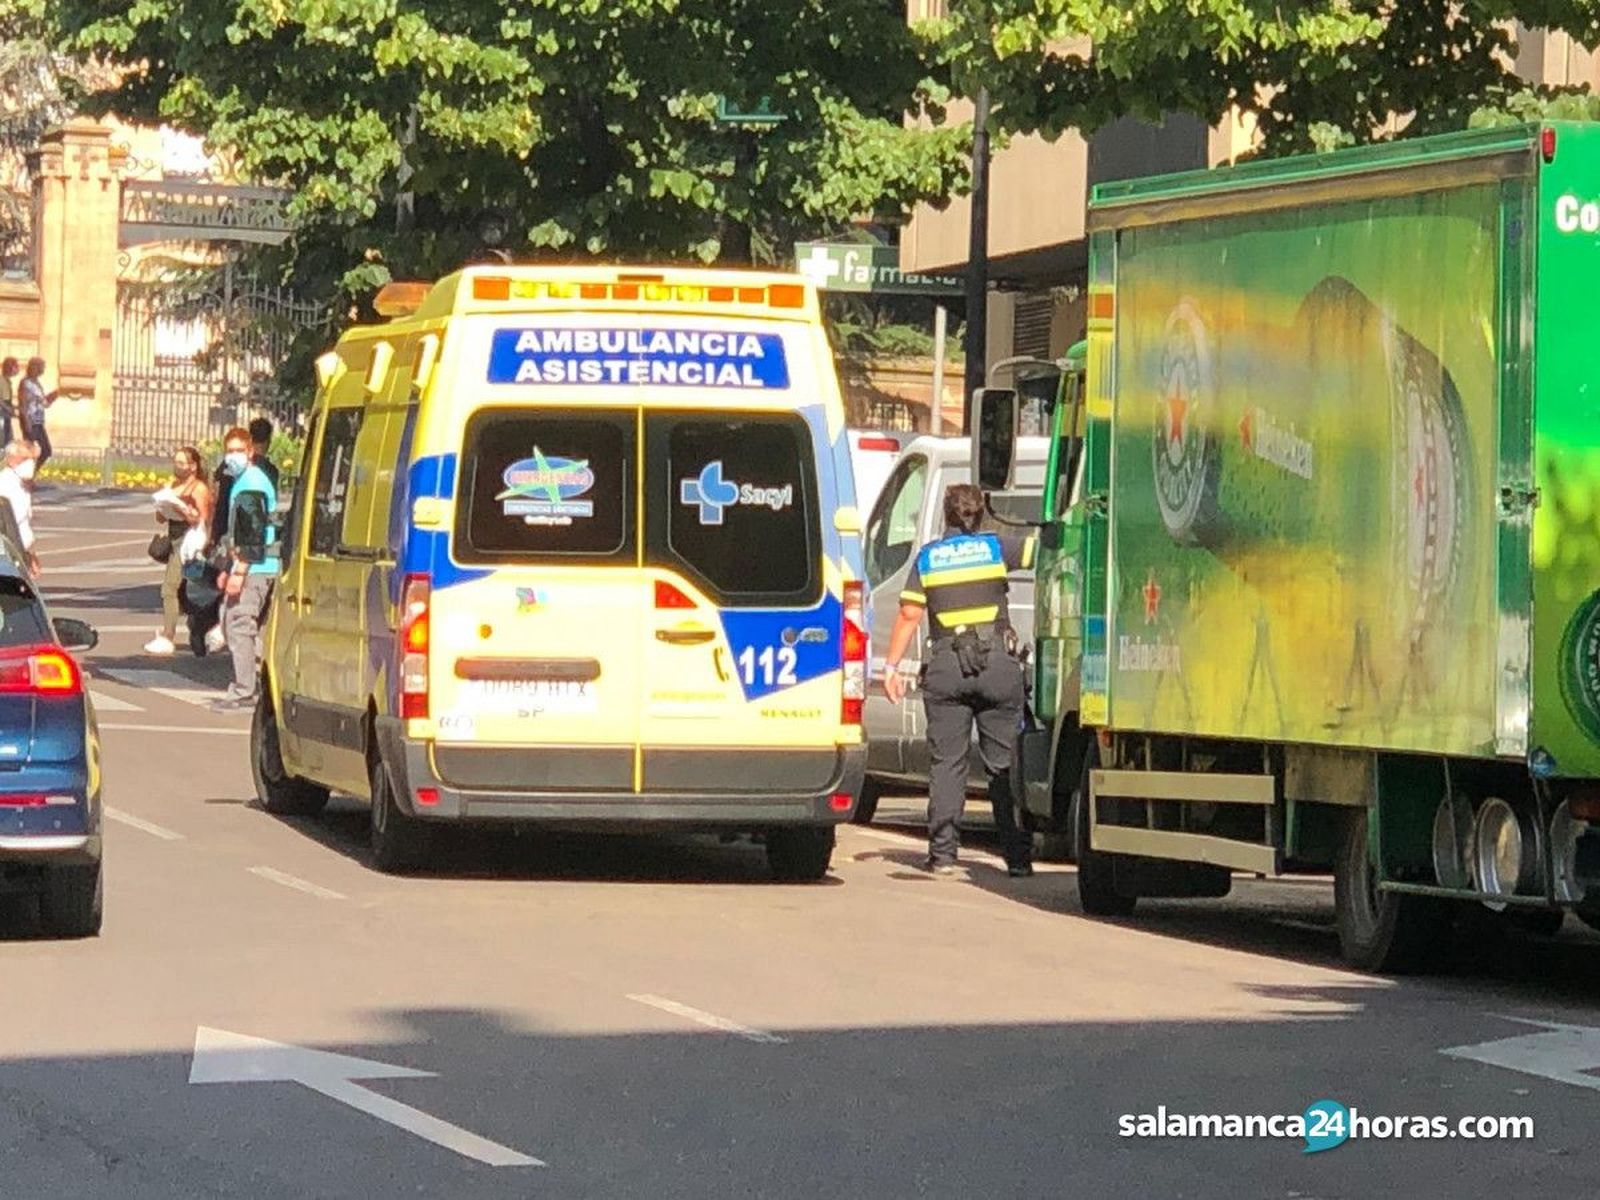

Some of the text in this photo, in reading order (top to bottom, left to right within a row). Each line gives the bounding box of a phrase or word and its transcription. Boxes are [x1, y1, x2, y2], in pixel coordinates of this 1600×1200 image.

[843, 250, 957, 285] farma
[514, 330, 765, 358] AMBULANCIA
[514, 359, 765, 387] ASISTENCIAL
[738, 483, 793, 510] Sacyl
[739, 644, 798, 686] 112
